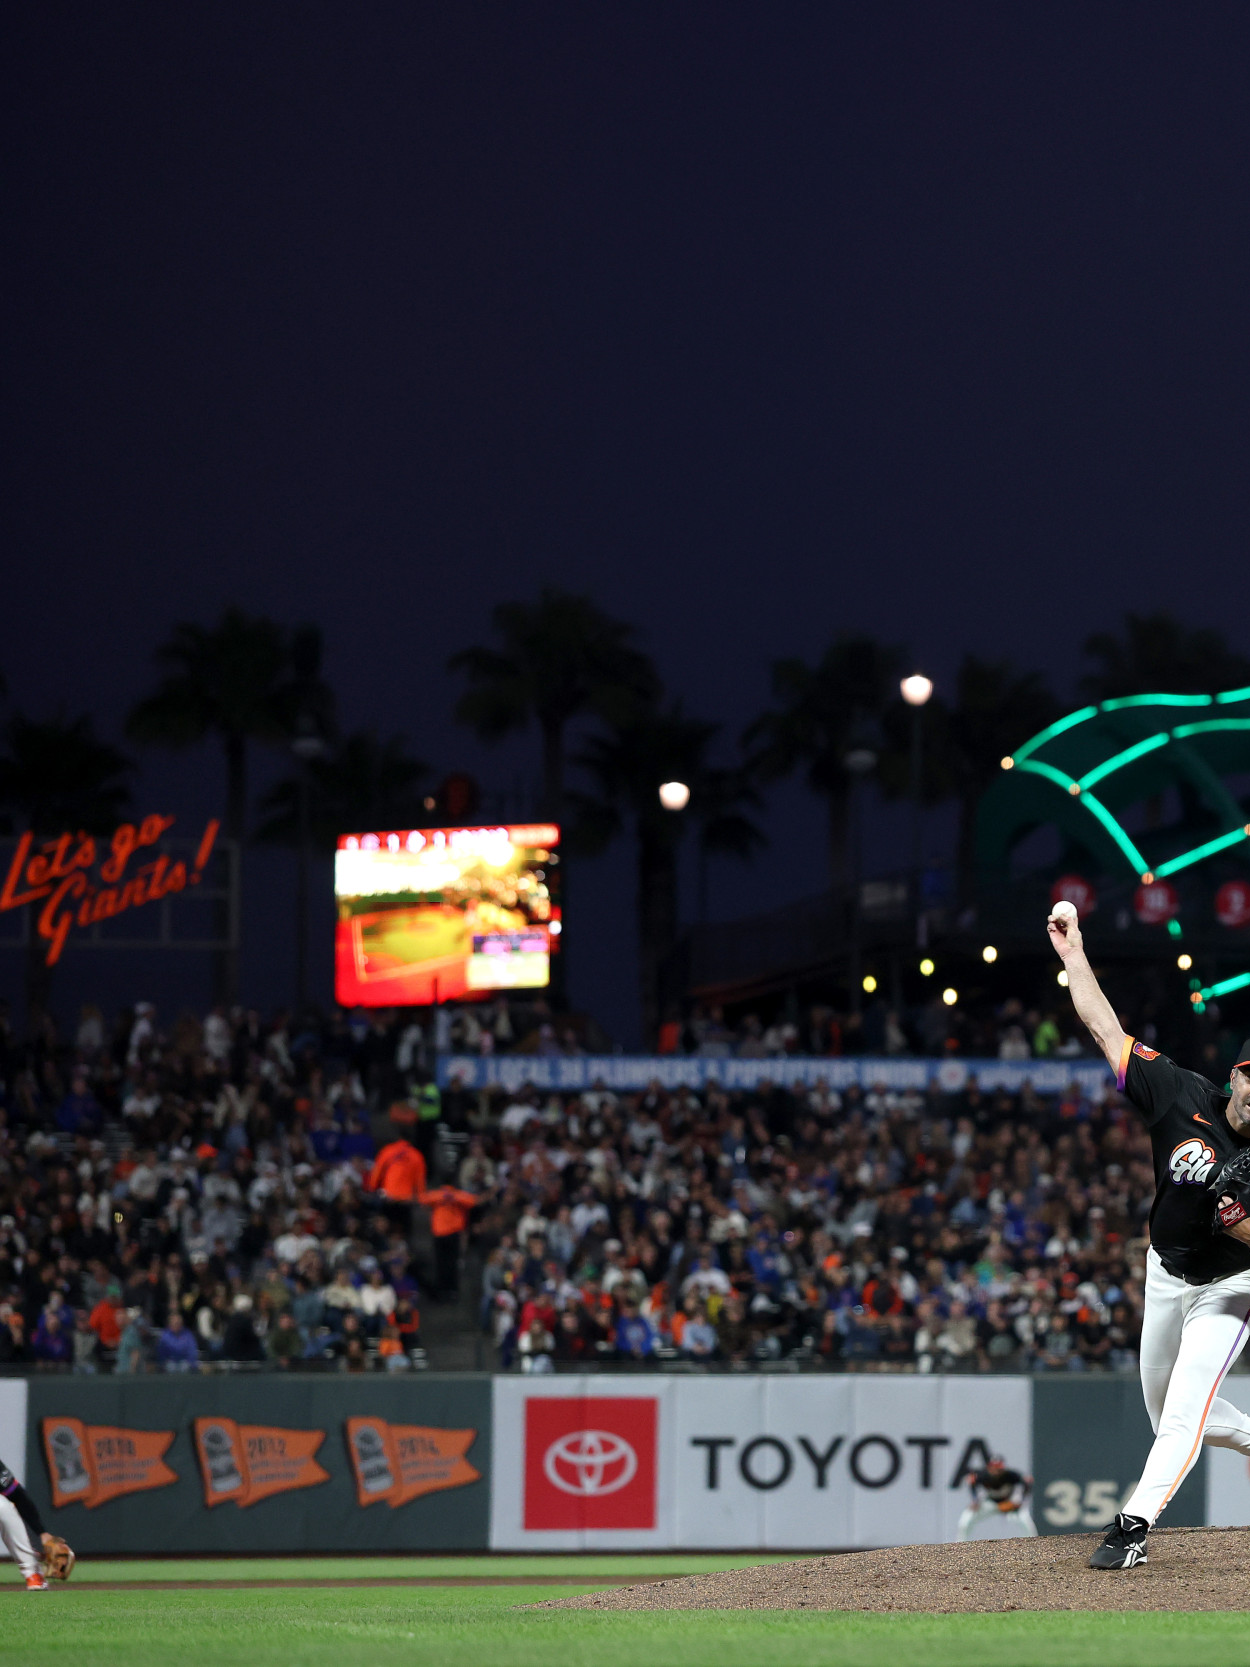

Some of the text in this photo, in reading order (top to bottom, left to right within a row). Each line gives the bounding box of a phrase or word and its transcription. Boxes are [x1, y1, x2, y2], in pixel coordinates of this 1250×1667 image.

[0, 814, 176, 913] Let's go
[37, 818, 220, 967] Giants!
[690, 1435, 995, 1491] TOYOTA
[1044, 1479, 1138, 1528] 35
